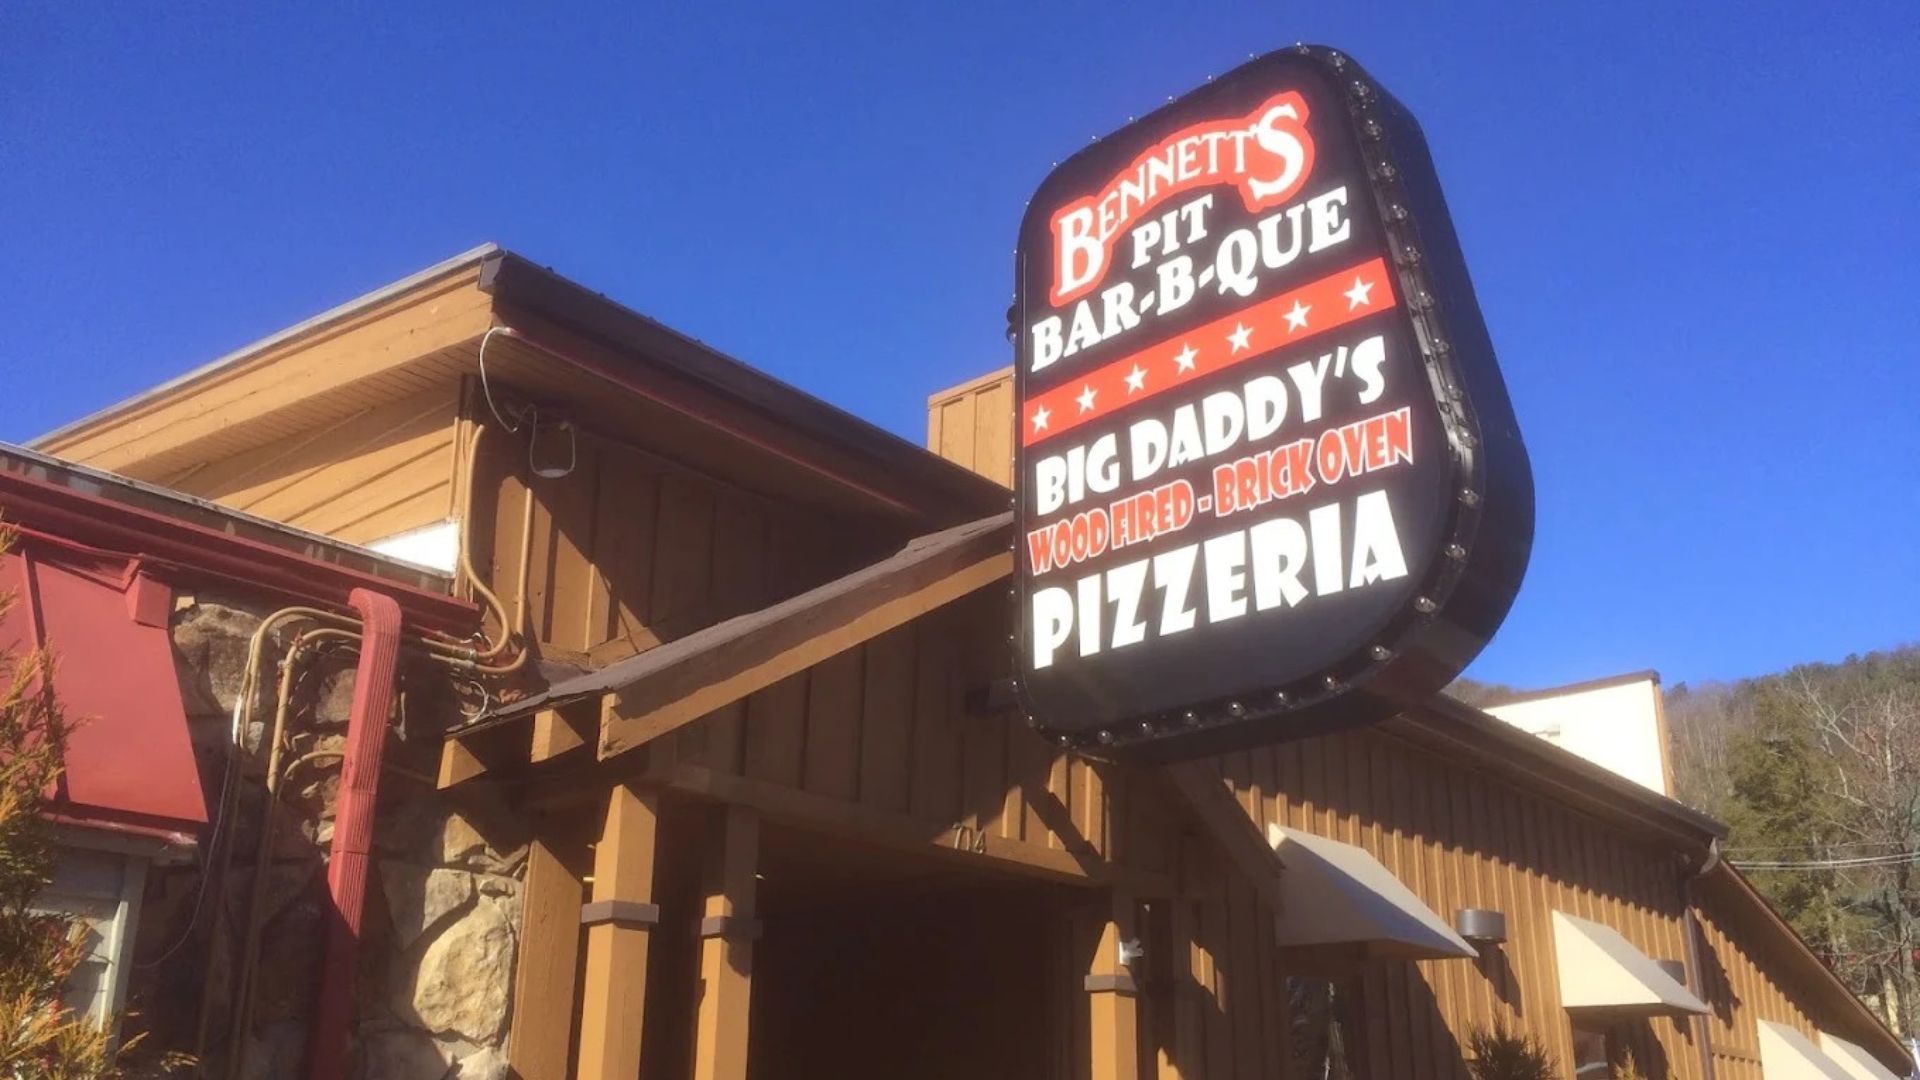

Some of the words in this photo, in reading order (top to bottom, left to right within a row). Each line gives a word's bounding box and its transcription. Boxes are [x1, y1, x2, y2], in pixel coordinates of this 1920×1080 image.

[1031, 187, 1350, 373] BAR-B-QUE
[1131, 194, 1213, 269] PIT
[1027, 507, 1107, 576] WOOD
[1110, 478, 1194, 549] FIRED
[1213, 438, 1316, 517] BRICK
[1316, 406, 1414, 485] OVEN
[1035, 432, 1120, 516] BIG
[1129, 336, 1386, 469] DADDY'S
[1032, 489, 1408, 669] PIZZERIA
